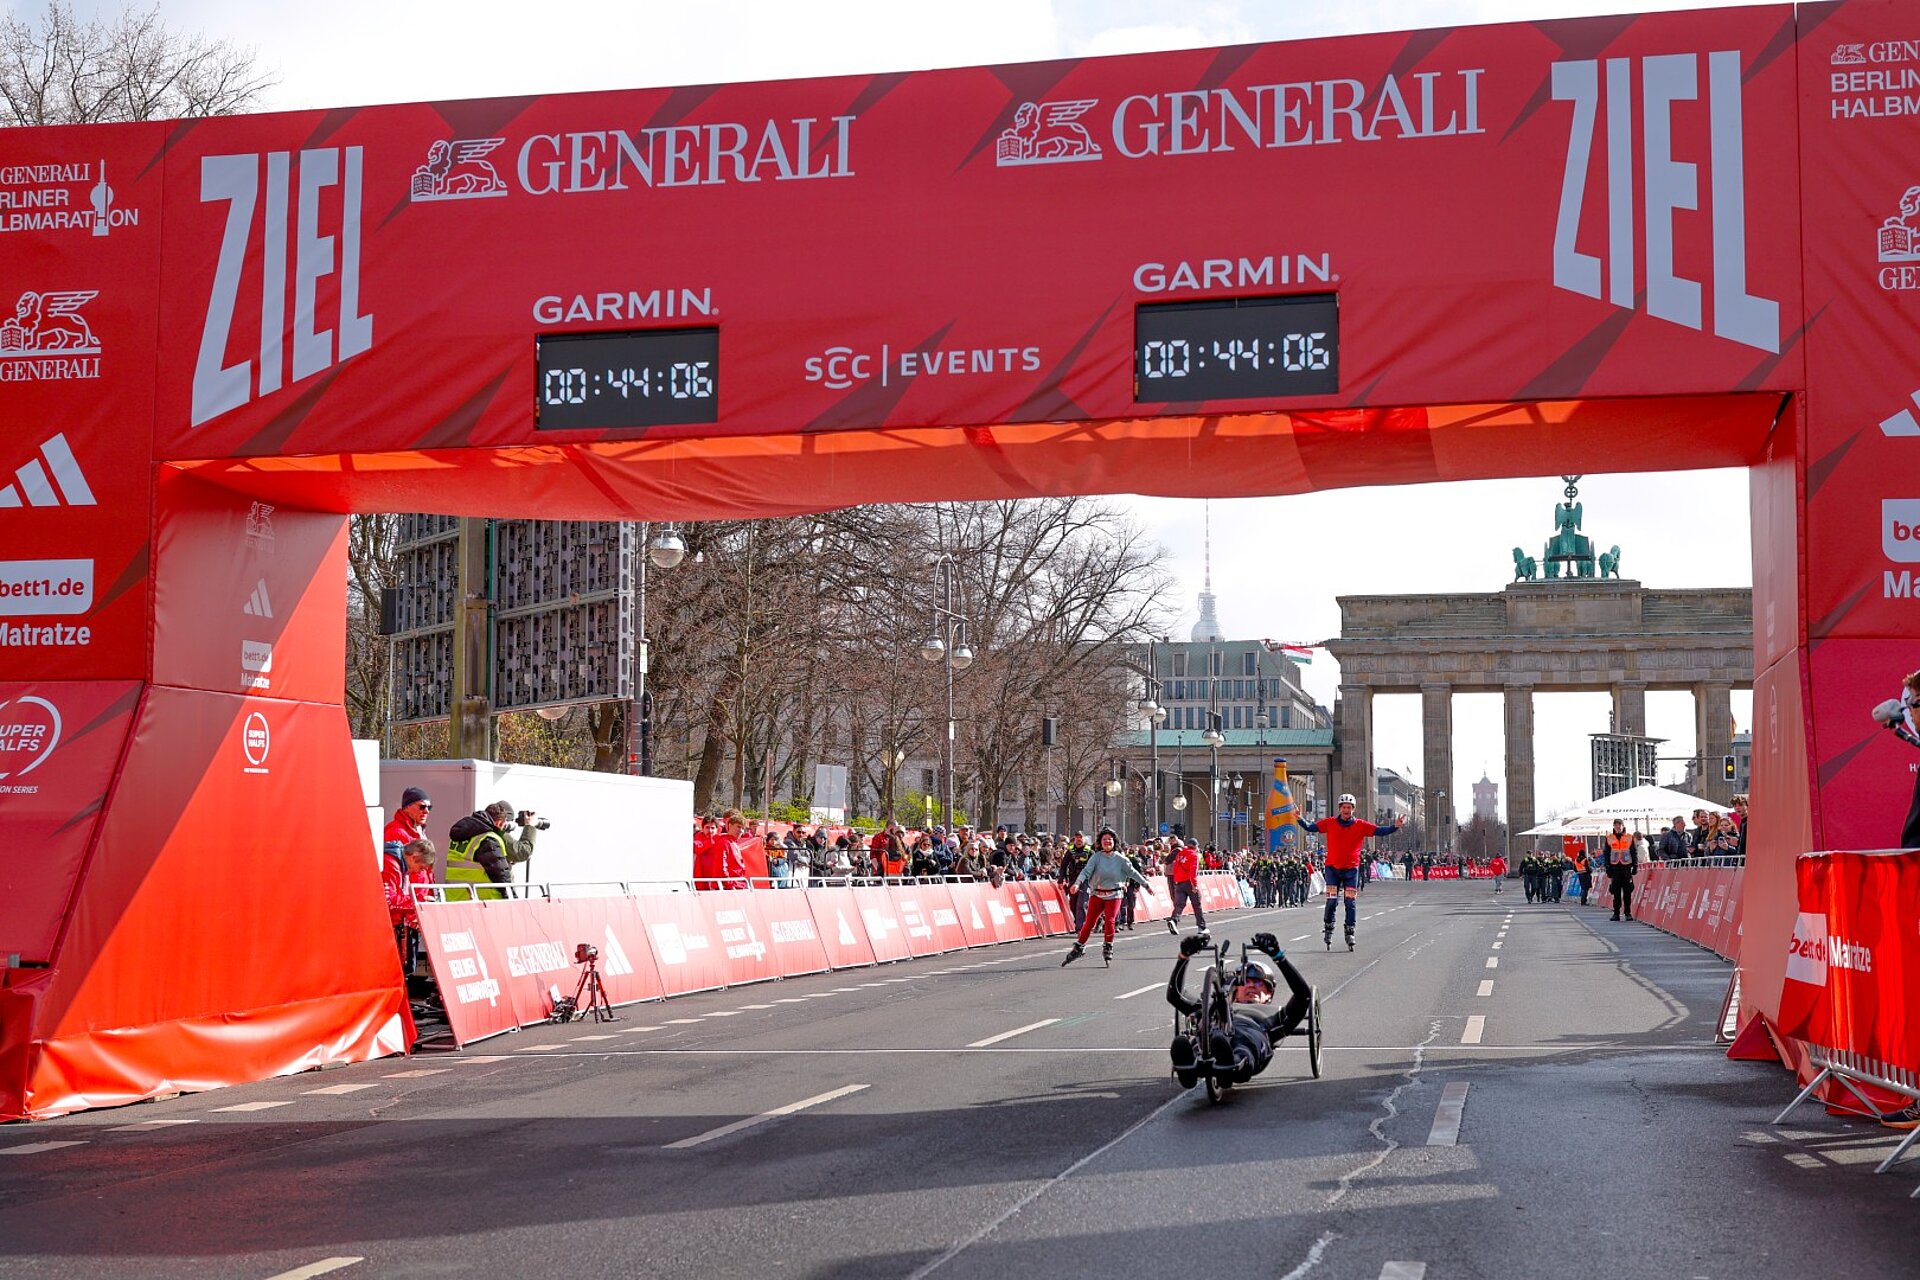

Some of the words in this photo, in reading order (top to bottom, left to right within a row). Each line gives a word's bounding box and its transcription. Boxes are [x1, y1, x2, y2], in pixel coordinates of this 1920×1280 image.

[1112, 68, 1486, 159] GENERALI
[0, 163, 91, 185] GENERALI
[517, 115, 857, 195] GENERALI
[1551, 49, 1780, 355] ZIEL
[191, 145, 374, 428] ZIEL
[0, 358, 101, 382] GENERALI
[804, 353, 871, 382] SCC
[900, 346, 1041, 377] EVENTS
[1144, 332, 1330, 378] 00:44:06
[544, 360, 714, 405] 00:44:06
[0, 577, 85, 598] bett1.de
